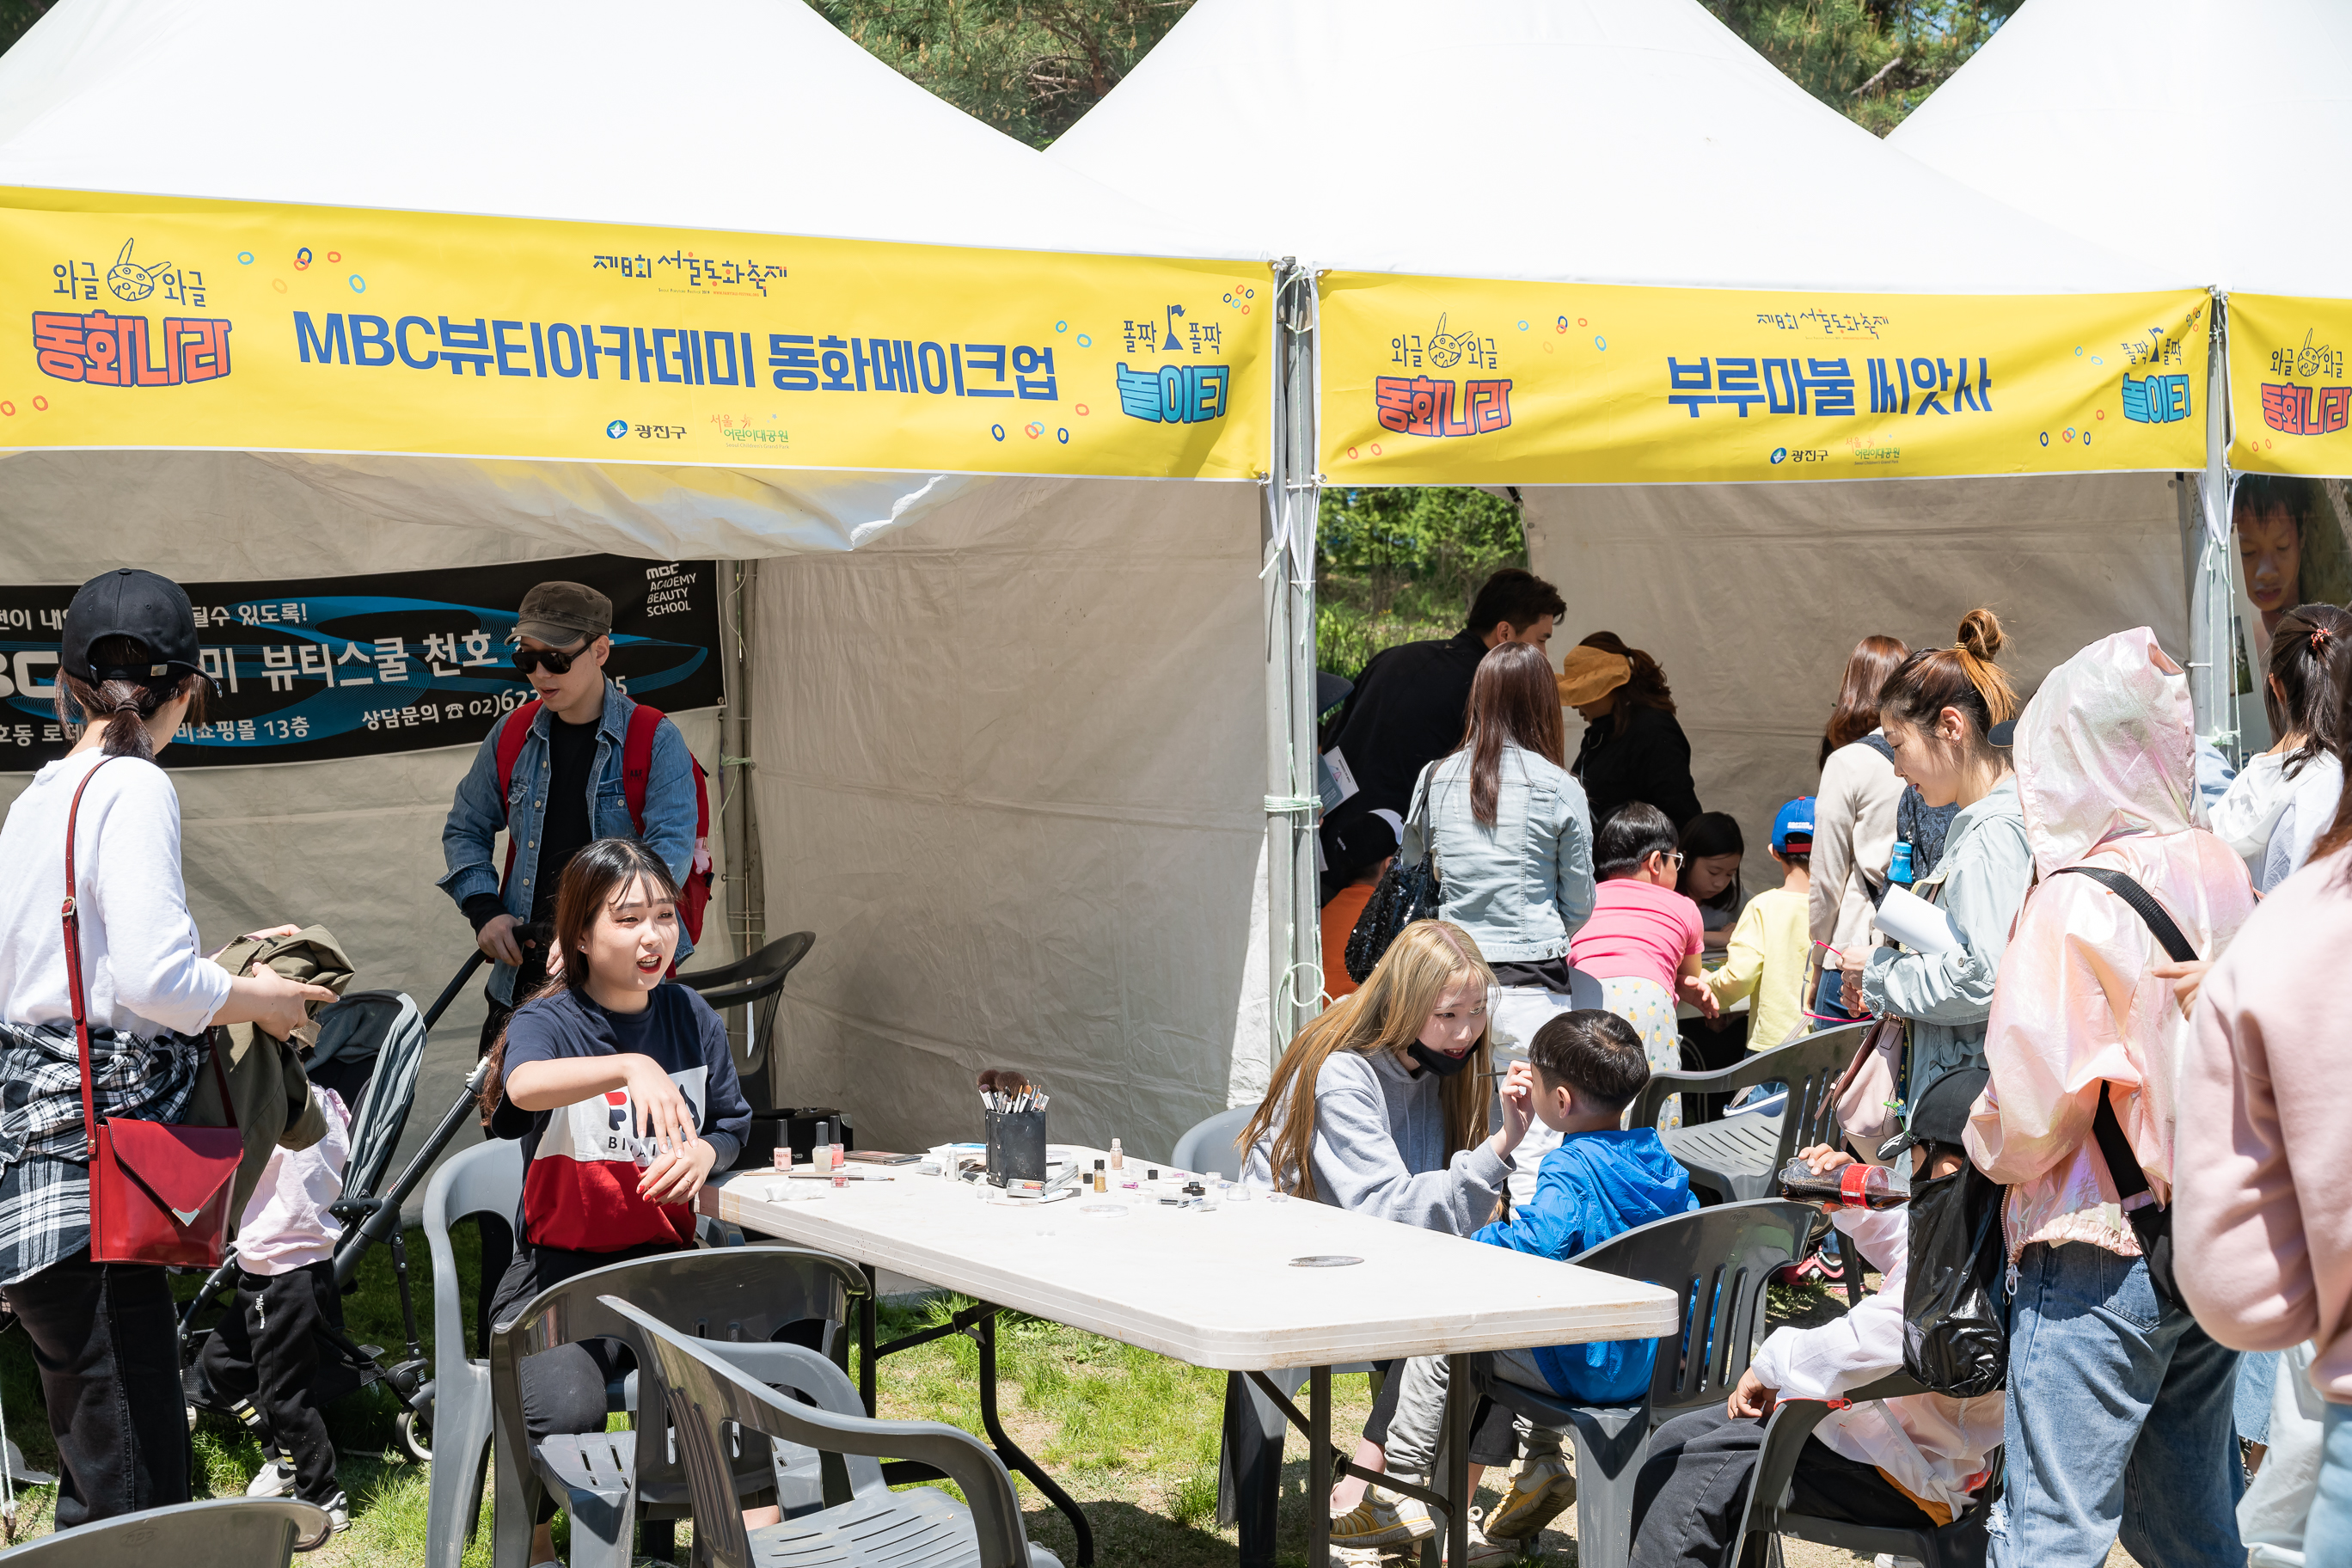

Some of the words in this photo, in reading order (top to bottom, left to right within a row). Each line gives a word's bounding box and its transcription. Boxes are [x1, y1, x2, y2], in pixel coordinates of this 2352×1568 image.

[53, 260, 100, 300] 와글
[162, 269, 206, 308] 와글
[593, 254, 652, 279] 제8회
[658, 250, 787, 297] 서울동화축제
[1123, 320, 1157, 353] 폴짝
[1189, 322, 1222, 354] 폴짝
[1756, 312, 1799, 329] 제8회
[1800, 308, 1890, 340] 서울동화축제
[32, 309, 233, 388] 동화나라
[292, 310, 756, 388] MBC뷰티아카데미
[768, 334, 1059, 401] 동화메이크업
[1392, 334, 1424, 367] 와글
[1467, 337, 1498, 370] 와글
[2121, 340, 2149, 364] 폴짝
[2163, 338, 2182, 365] 폴짝
[2269, 347, 2294, 376] 와글
[2324, 350, 2343, 378] 와글
[1116, 361, 1230, 424] 놀이터
[1667, 356, 1855, 418] 부루마불
[1866, 357, 1994, 416] 씨앗사
[2122, 372, 2191, 424] 놀이터
[1375, 375, 1513, 438] 동화나라
[2261, 382, 2352, 435] 동화나라
[634, 424, 688, 439] 광진구
[710, 413, 733, 433] 서울
[723, 428, 789, 443] 어린이대공원
[1791, 450, 1828, 462] 광진구
[1846, 437, 1862, 454] 서울
[1854, 447, 1901, 460] 어린이대공원
[646, 563, 679, 579] MBC
[650, 573, 696, 592] ACADEMY
[646, 587, 689, 604] BEAUTY
[646, 600, 692, 617] SCHOOL
[237, 603, 307, 626] 있도록!
[261, 636, 409, 692] 뷰티스쿨
[422, 629, 498, 677] 천호
[263, 716, 310, 738] 13층
[361, 704, 439, 731] 상담문의
